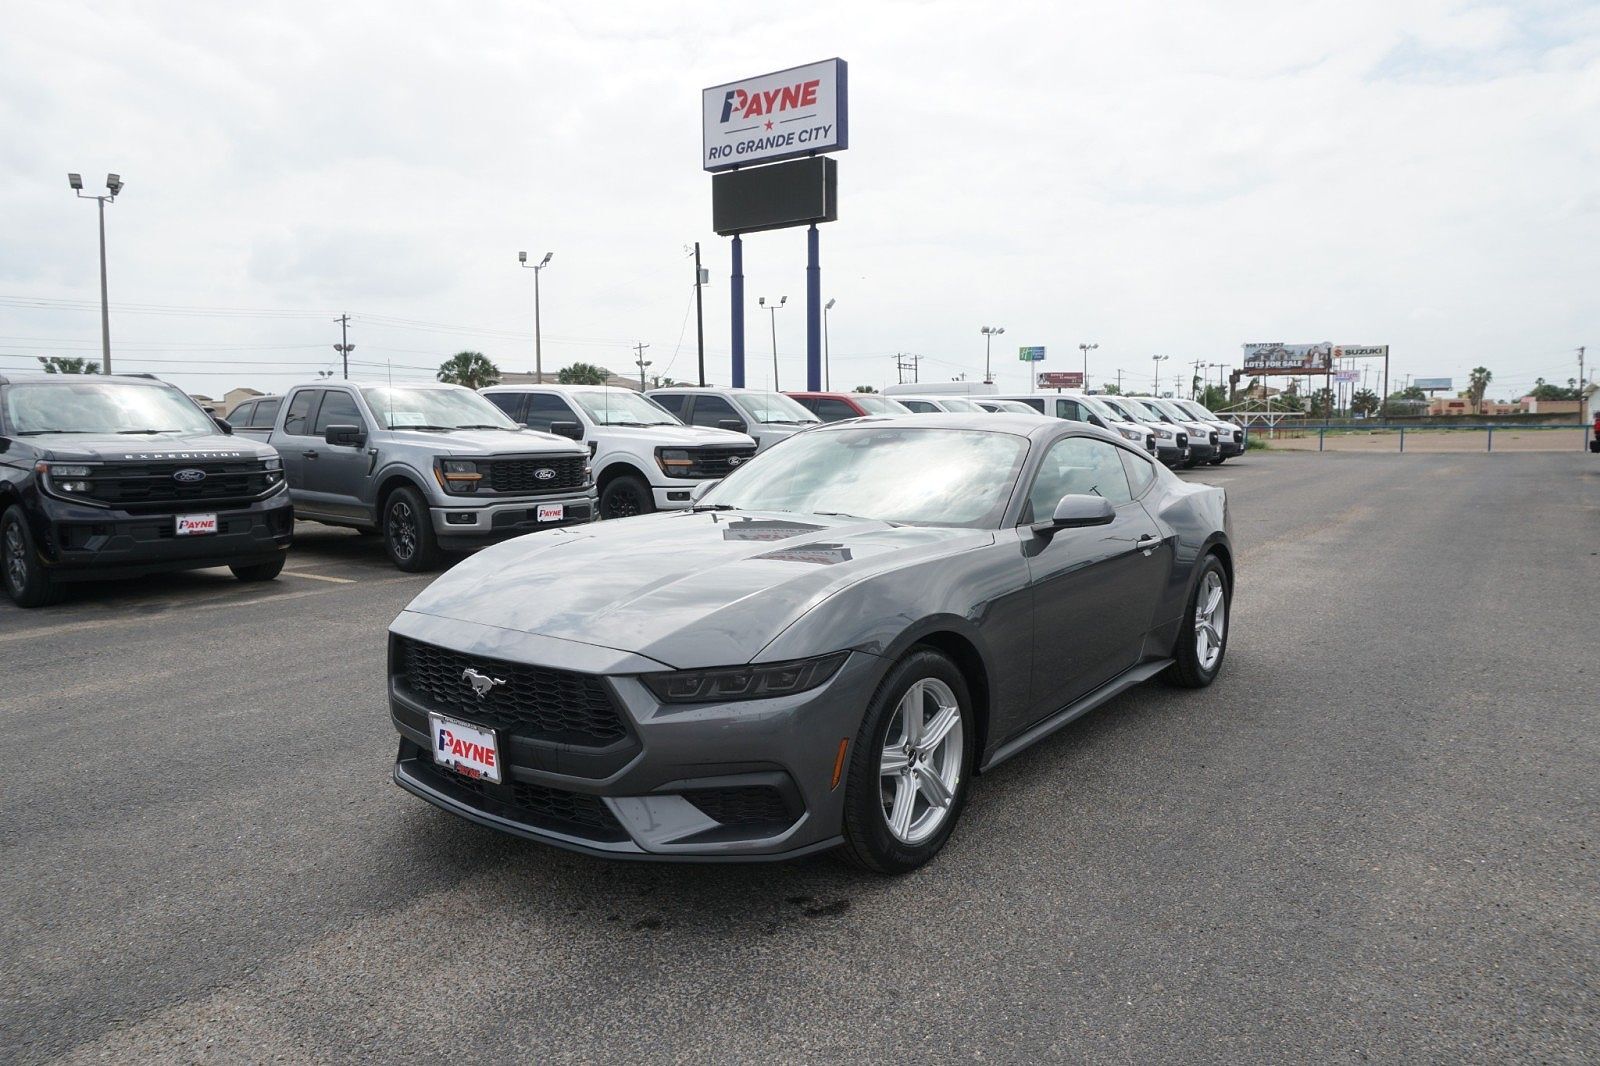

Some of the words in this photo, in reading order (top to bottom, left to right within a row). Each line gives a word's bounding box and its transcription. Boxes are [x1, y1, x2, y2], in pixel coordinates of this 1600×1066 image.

[720, 79, 820, 123] PAYNE
[708, 144, 732, 160] RIO
[736, 132, 795, 155] GRANDE
[798, 124, 832, 143] CITY
[1345, 348, 1382, 356] SUZUKI
[179, 520, 214, 529] PAYNE
[439, 729, 496, 767] PAYNE
